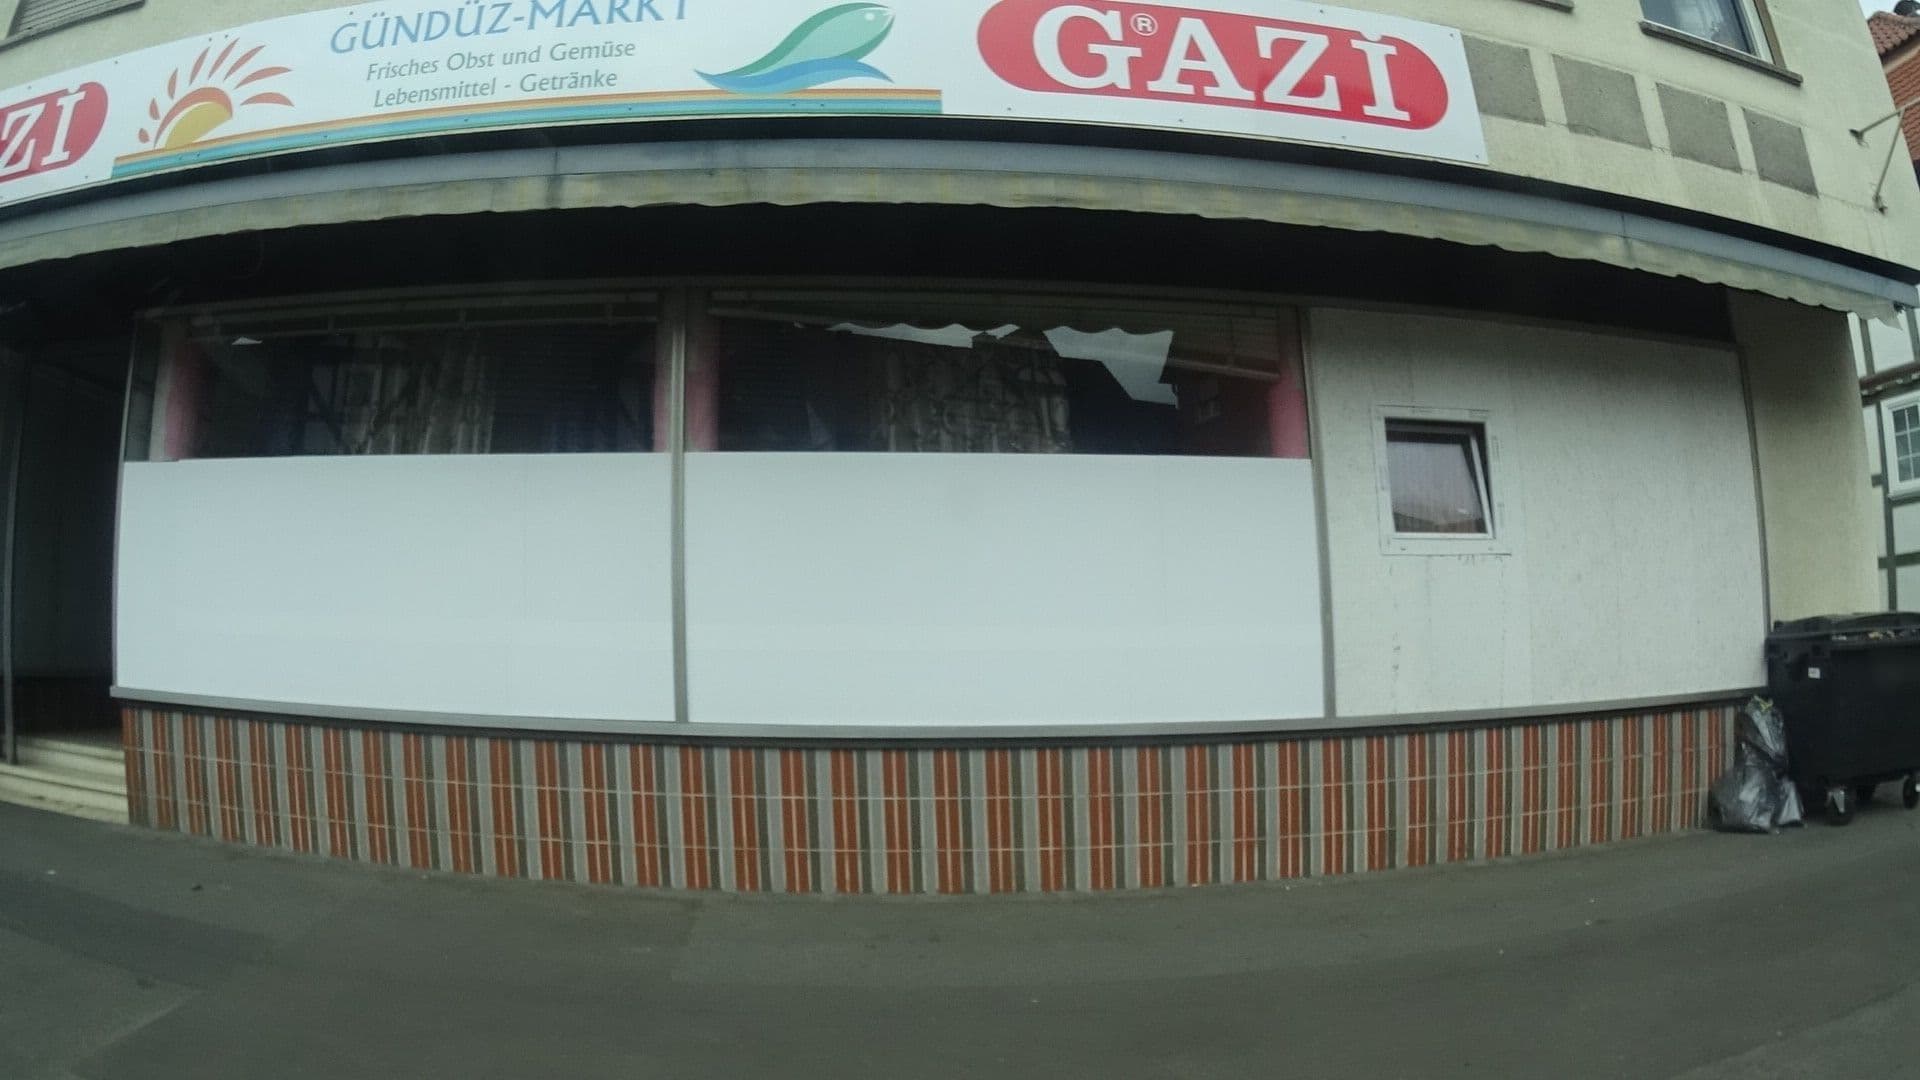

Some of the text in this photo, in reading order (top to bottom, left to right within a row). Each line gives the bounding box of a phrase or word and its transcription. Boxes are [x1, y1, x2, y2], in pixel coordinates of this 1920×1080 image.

[367, 41, 636, 80] Frisches Obst und Gemüse
[374, 77, 496, 107] Lebensmittel
[520, 69, 617, 91] Getränke
